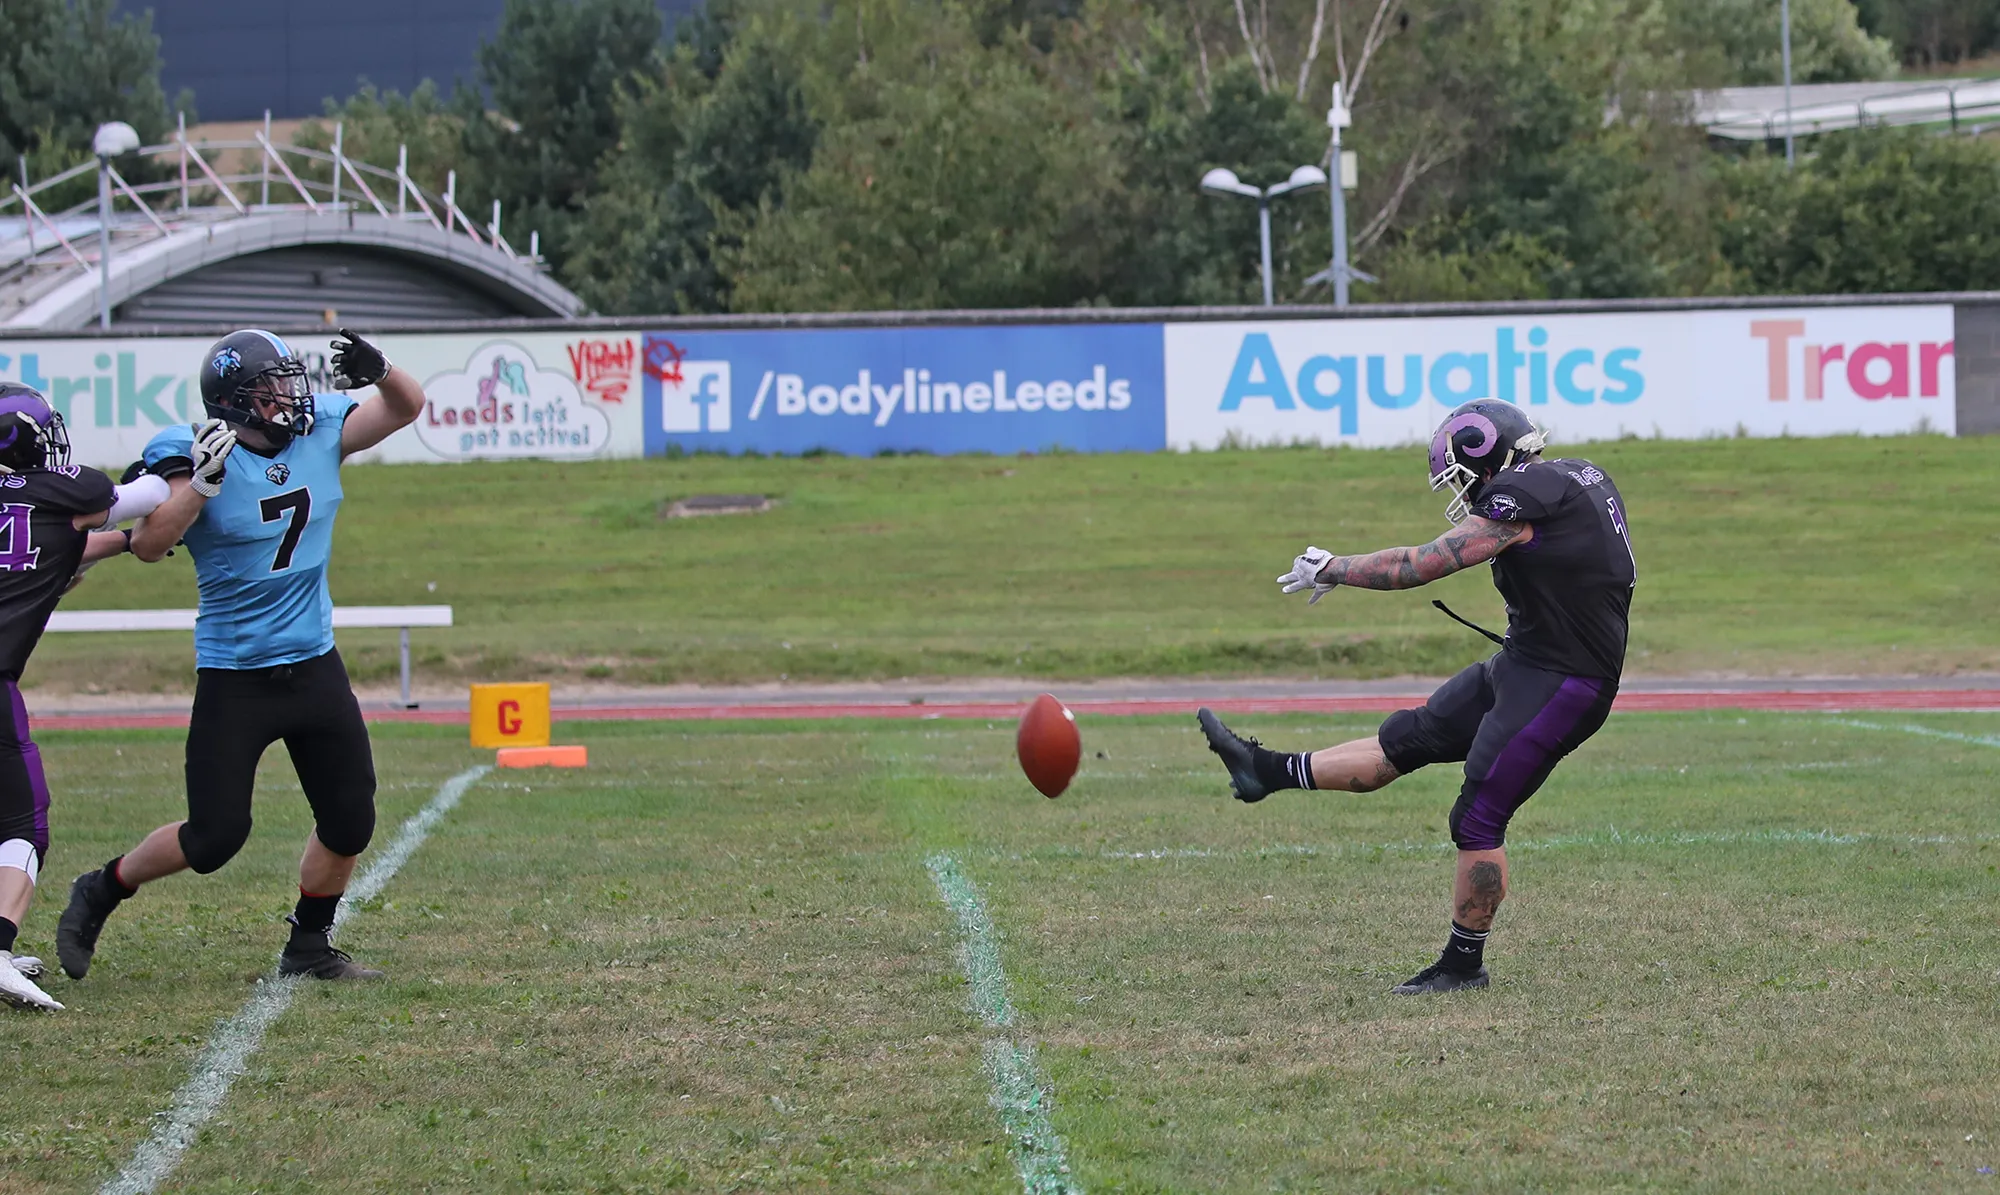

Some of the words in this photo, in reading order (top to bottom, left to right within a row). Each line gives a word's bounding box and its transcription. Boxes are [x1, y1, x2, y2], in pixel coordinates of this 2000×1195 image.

[427, 396, 514, 426] Leeds
[523, 397, 568, 424] let's
[748, 365, 1131, 426] /BodylineLeeds
[1218, 326, 1645, 436] Aquatics
[460, 428, 499, 451] get
[510, 424, 590, 446] active!
[0, 503, 41, 572] 4
[258, 485, 312, 573] 7
[498, 699, 523, 736] G
